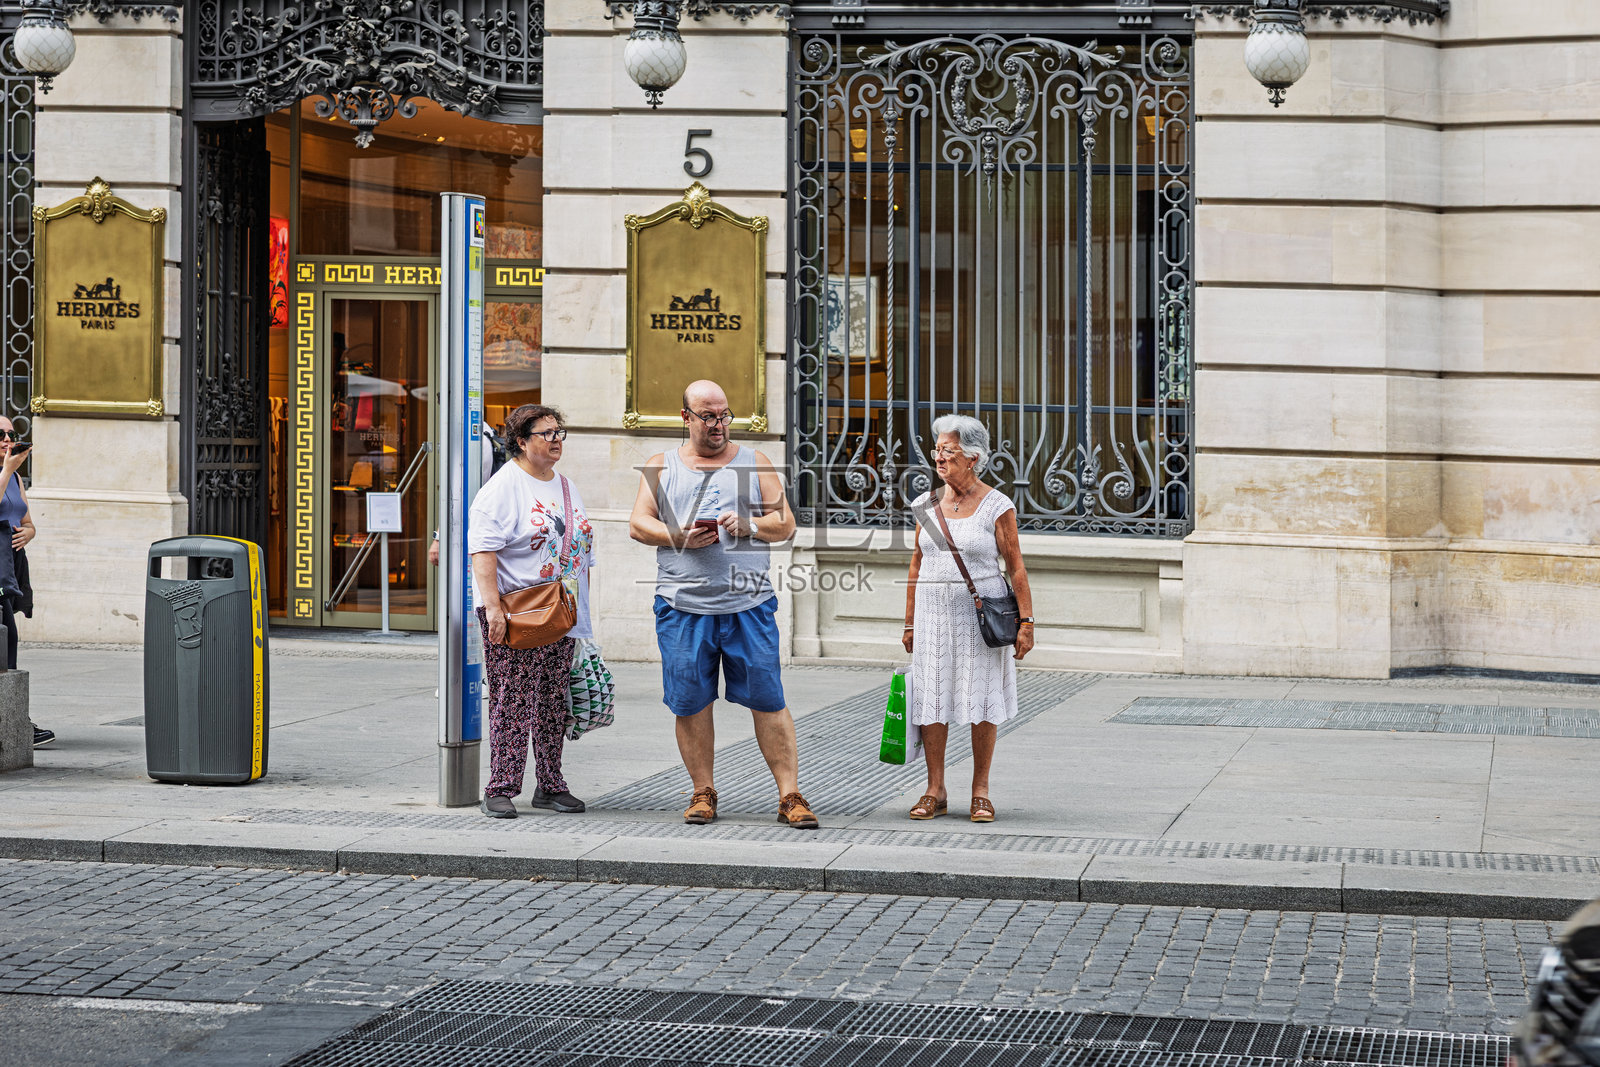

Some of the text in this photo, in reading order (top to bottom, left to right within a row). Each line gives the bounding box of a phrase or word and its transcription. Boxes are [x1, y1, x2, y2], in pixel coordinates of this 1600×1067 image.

[683, 128, 713, 178] 5
[57, 301, 140, 318] HERMÈS
[81, 320, 115, 330] PARIS
[650, 312, 741, 330] HERMÈS
[677, 333, 714, 343] PARIS
